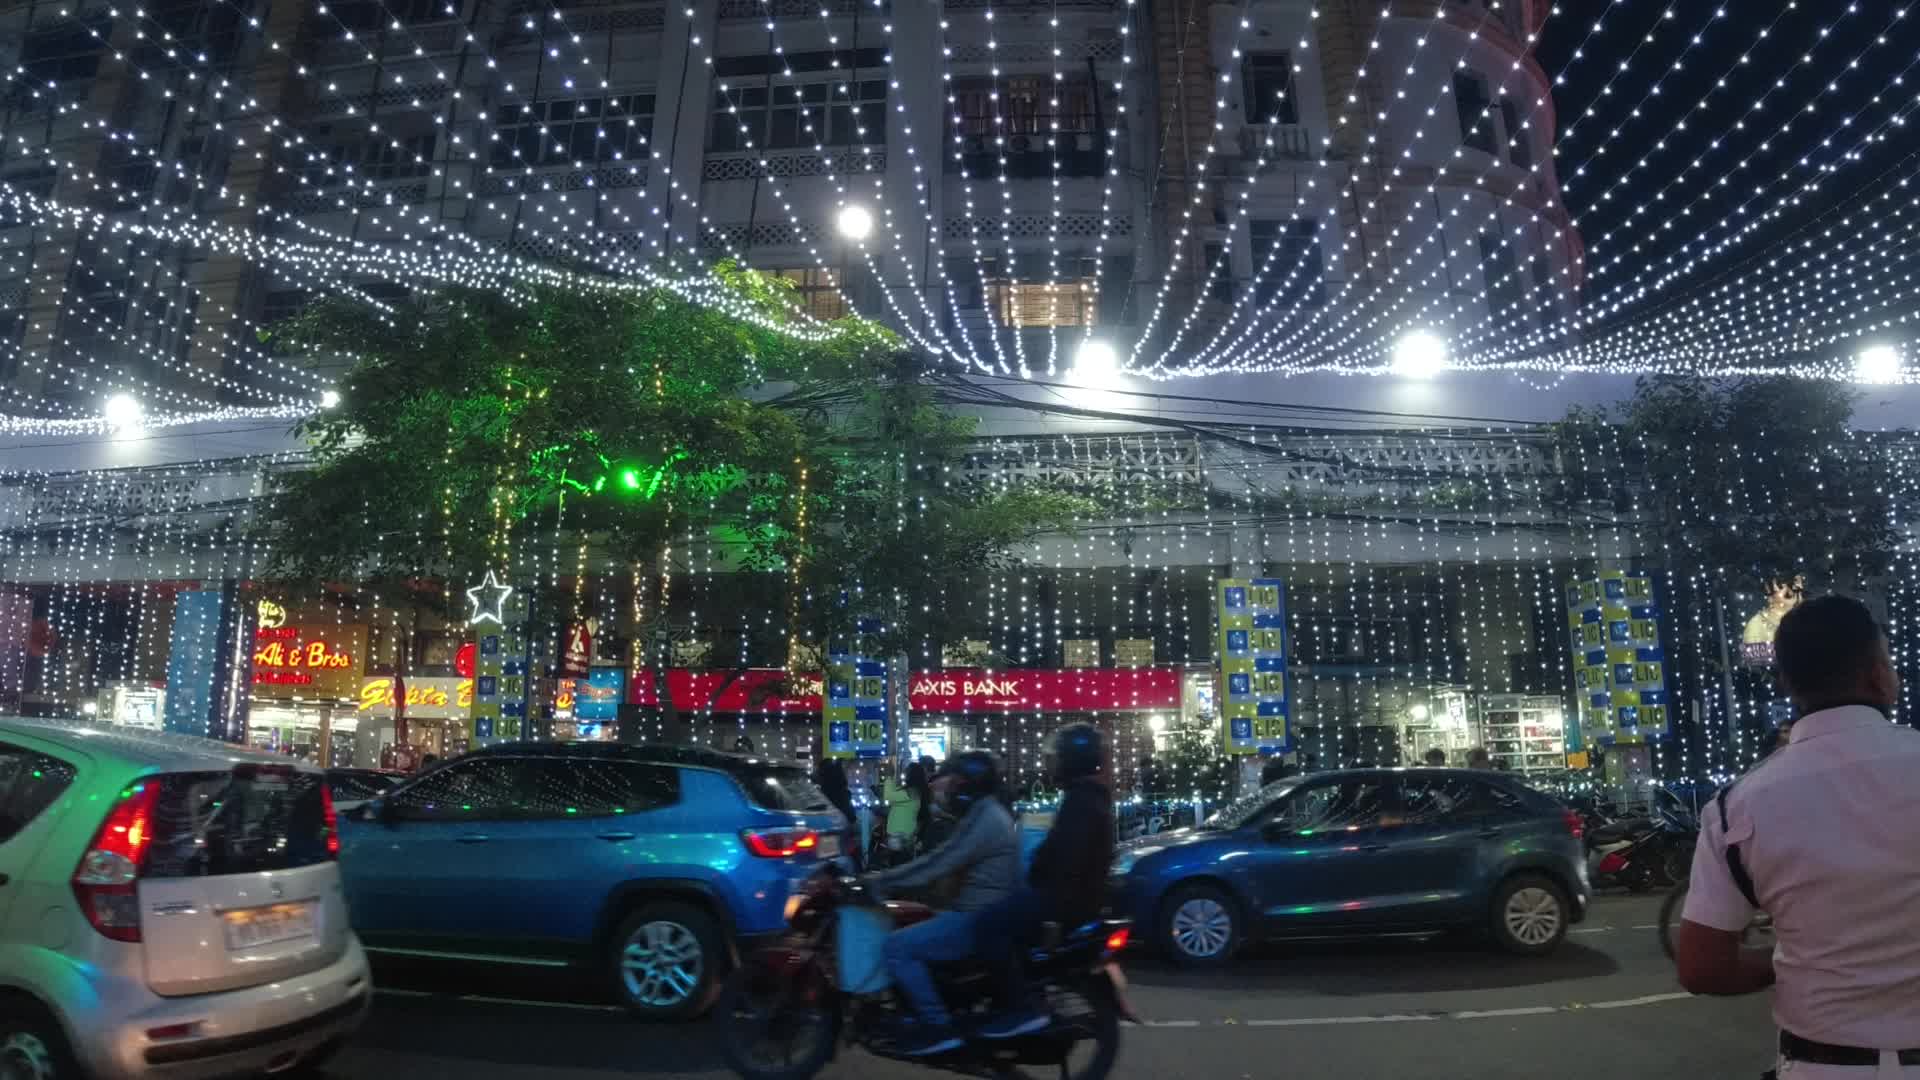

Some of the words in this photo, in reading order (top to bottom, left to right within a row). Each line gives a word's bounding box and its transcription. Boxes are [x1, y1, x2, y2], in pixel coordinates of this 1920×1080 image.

[288, 649, 302, 666] &
[306, 642, 350, 666] Bros
[911, 681, 957, 696] AXIS
[963, 680, 1019, 696] BANK
[1640, 706, 1666, 725] LIC
[1255, 719, 1282, 737] LIC
